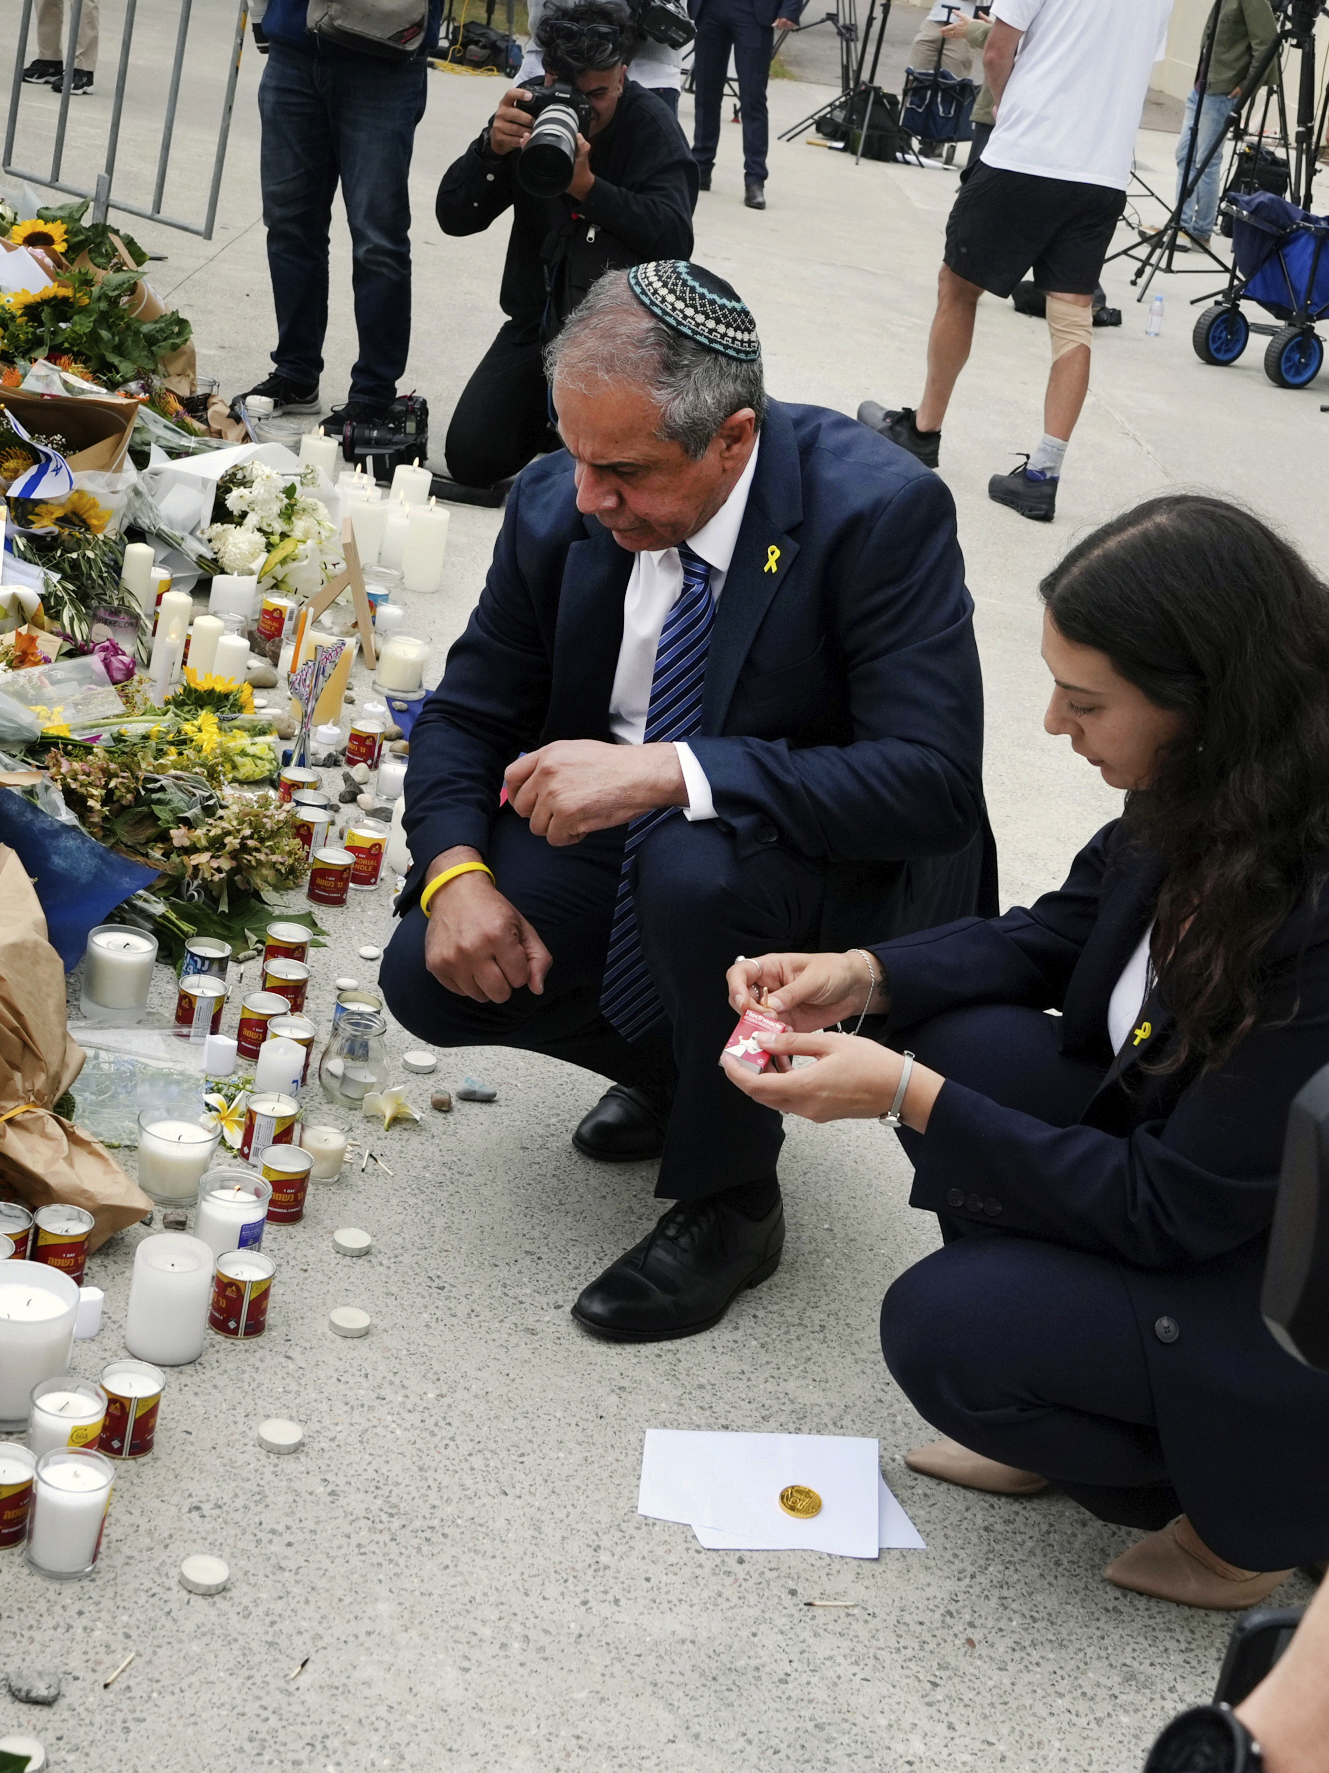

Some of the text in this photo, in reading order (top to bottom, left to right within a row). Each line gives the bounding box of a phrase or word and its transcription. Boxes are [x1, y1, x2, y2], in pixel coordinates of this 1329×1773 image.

[745, 1009, 783, 1030] Redheads
[47, 1255, 85, 1267] נר נשמה
